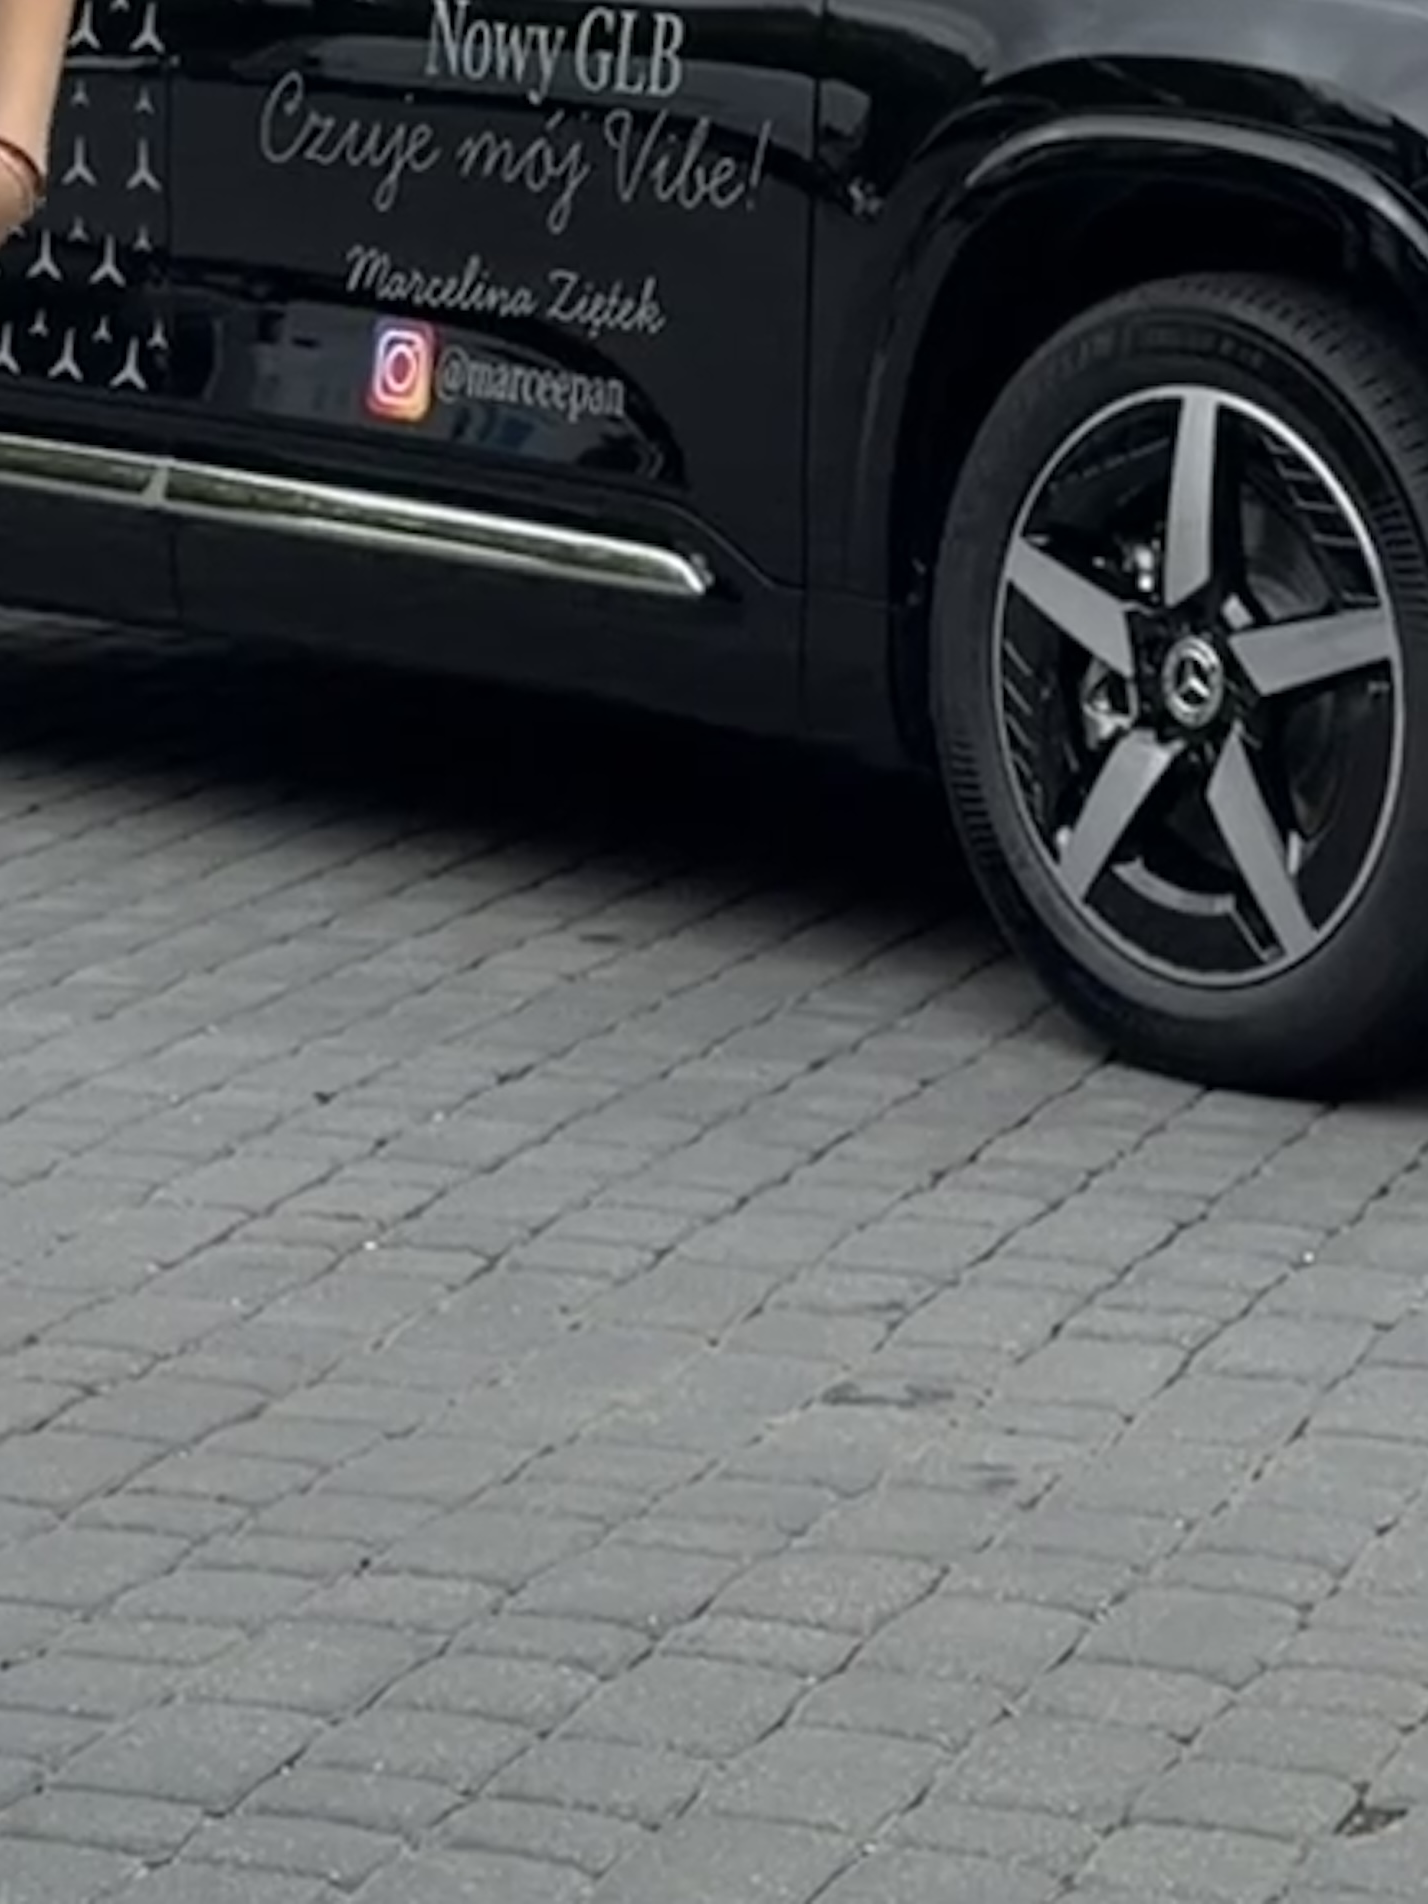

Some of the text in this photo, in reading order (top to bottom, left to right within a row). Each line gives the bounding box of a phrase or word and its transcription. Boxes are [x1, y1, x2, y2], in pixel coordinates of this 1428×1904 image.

[575, 7, 684, 96] GLB
[260, 71, 771, 234] Czuje mój Vibe!
[346, 244, 667, 339] Marcelina Ziętek
[436, 346, 626, 424] @marceepan
